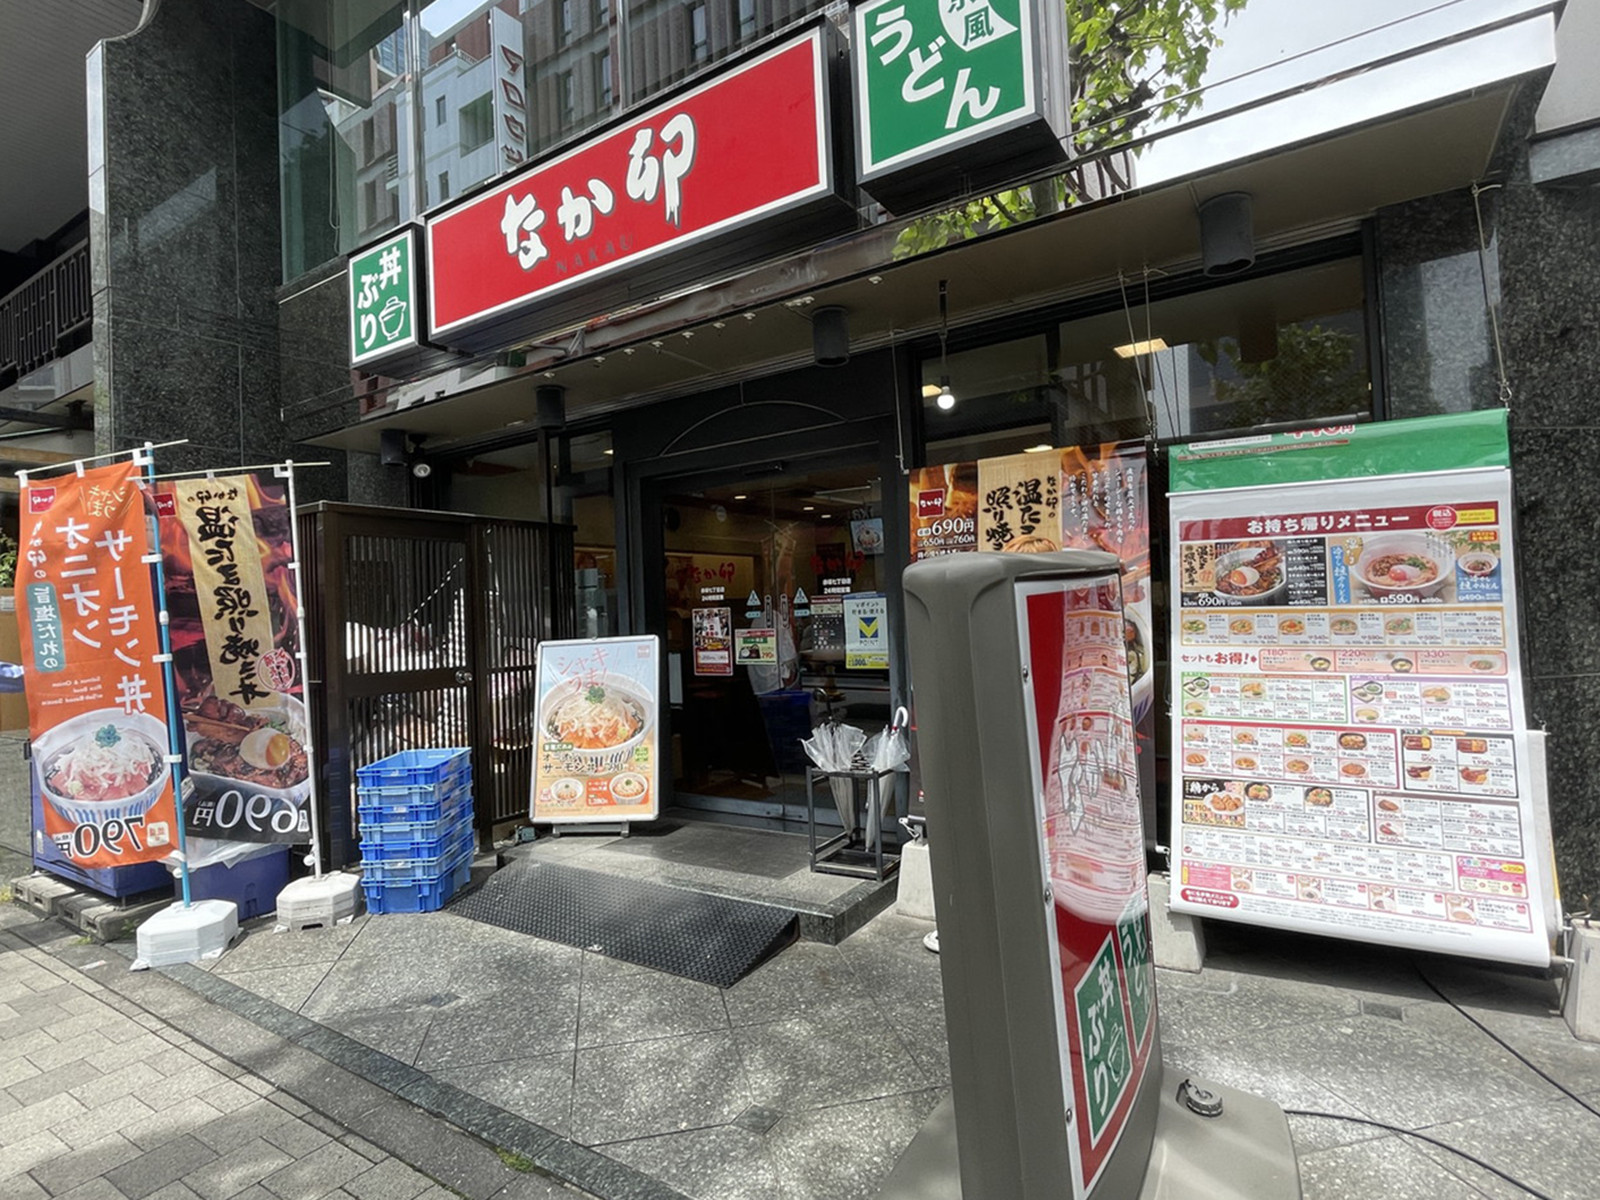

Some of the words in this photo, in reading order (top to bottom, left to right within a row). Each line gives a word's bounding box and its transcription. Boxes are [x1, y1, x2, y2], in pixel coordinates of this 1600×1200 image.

[870, 5, 1001, 129] うどん
[501, 113, 696, 270] なか卯
[555, 233, 634, 273] NAKAU
[357, 247, 400, 348] 丼ぶり
[920, 498, 942, 508] なか卯
[1046, 476, 1058, 518] なか卯の
[932, 518, 974, 536] 690円
[1247, 515, 1410, 534] お持ち帰りメニュー
[557, 648, 609, 675] シャキ
[569, 668, 608, 692] うま!
[1087, 955, 1115, 1117] 丼ぶり
